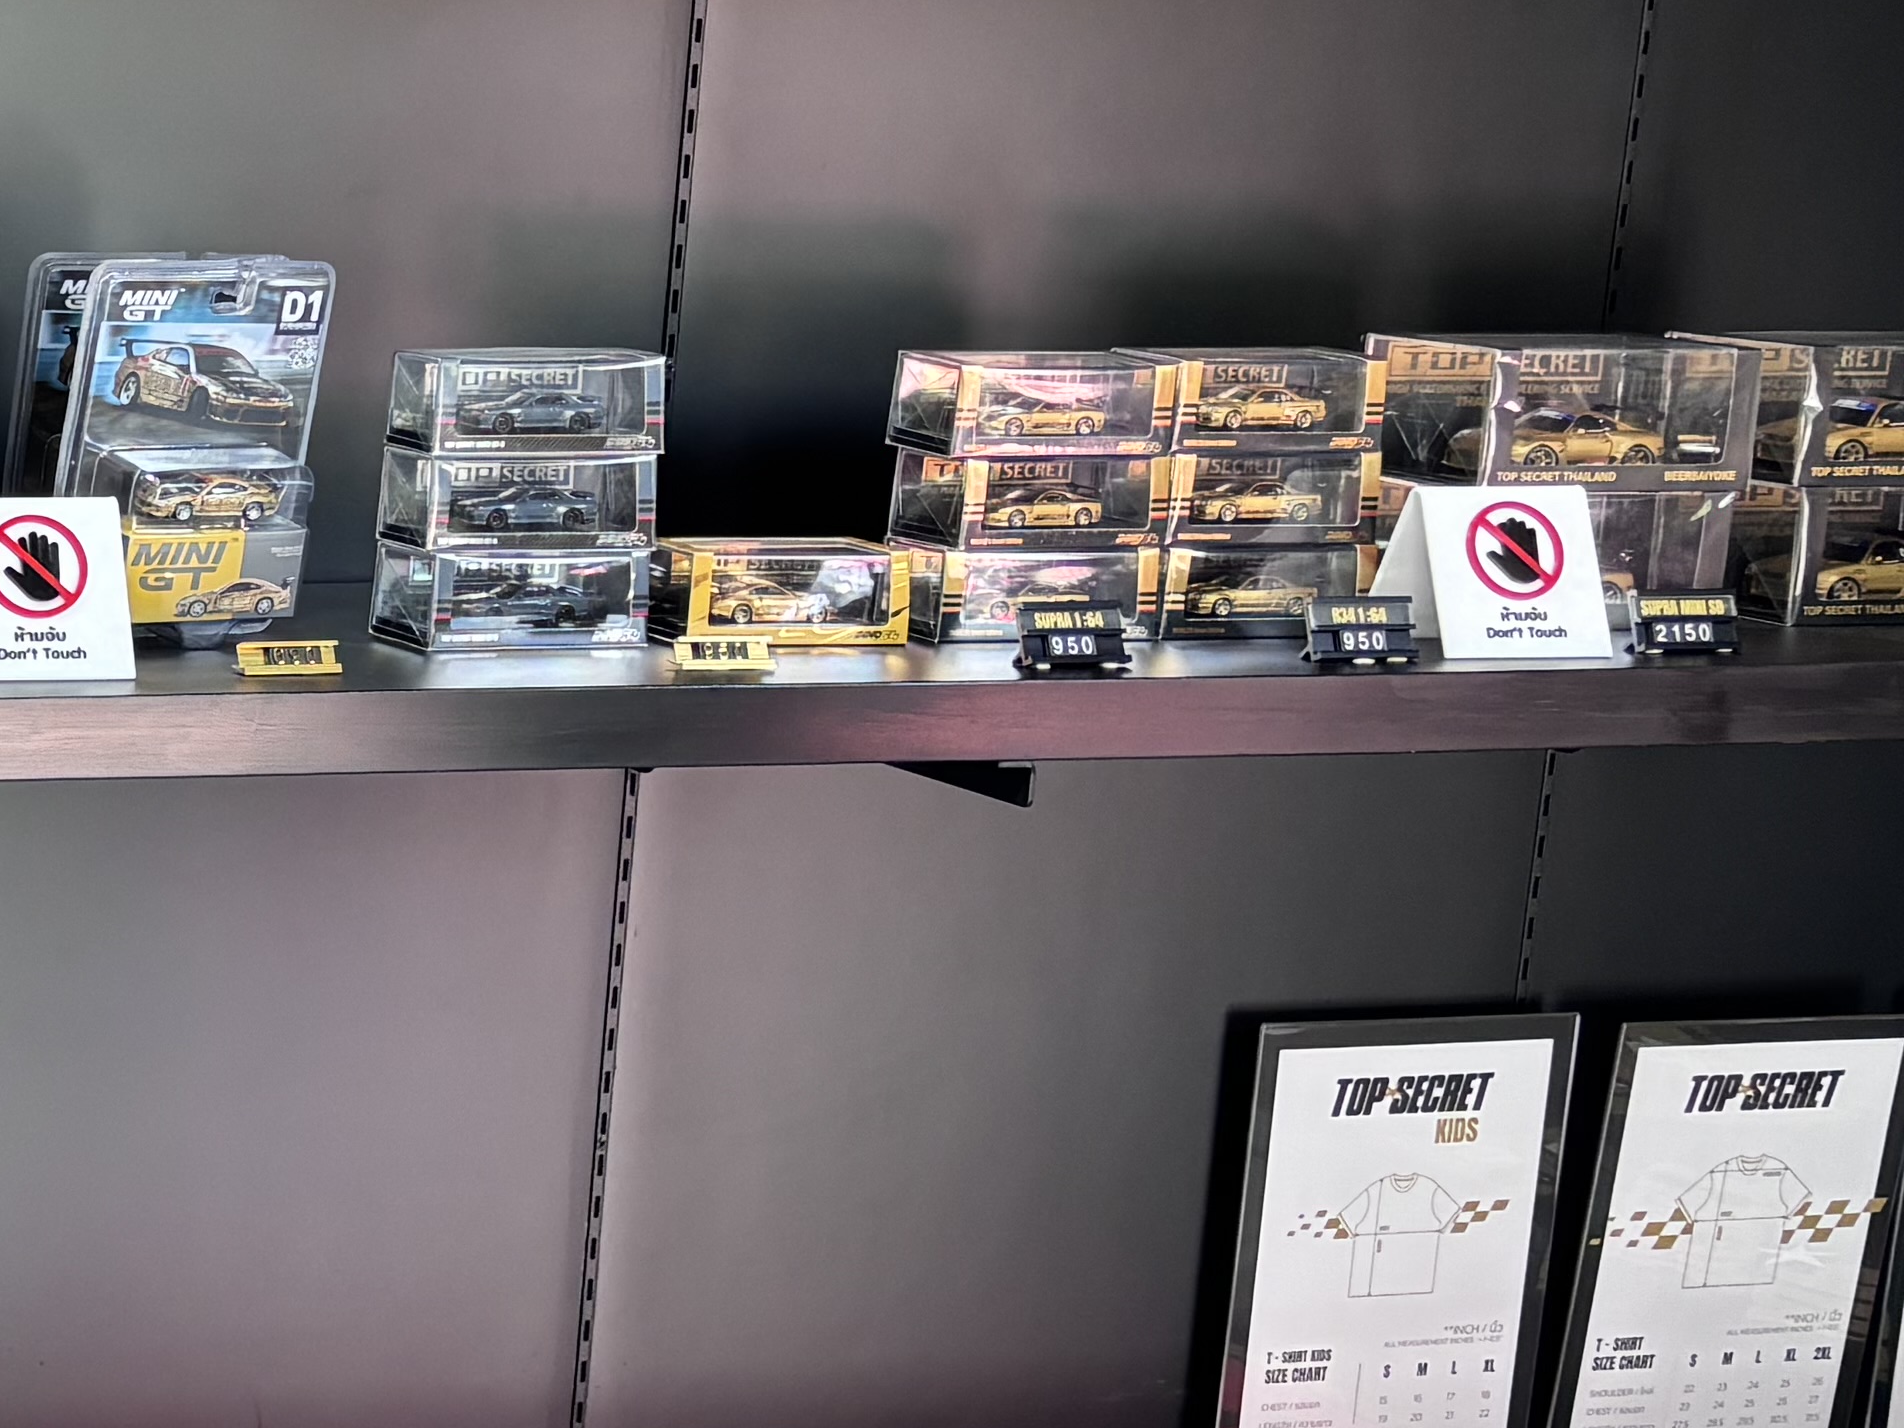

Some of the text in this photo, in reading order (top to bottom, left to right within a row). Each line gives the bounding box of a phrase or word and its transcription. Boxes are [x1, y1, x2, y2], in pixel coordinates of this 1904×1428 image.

[119, 289, 178, 308] MINI
[281, 289, 325, 324] D1
[122, 305, 172, 321] GT
[1403, 351, 1485, 372] TOP
[1213, 366, 1281, 384] SECRET
[1001, 463, 1067, 481] SECRET
[1497, 471, 1617, 482] TOP SECRET THAILAND
[131, 541, 229, 567] MINI
[139, 566, 219, 592] GT
[1033, 611, 1072, 629] SUPRA
[1500, 606, 1548, 622] ห้ามจับ
[14, 626, 67, 643] ห้ามจับ
[1342, 629, 1384, 651] 950
[1486, 626, 1568, 639] Don't Touch
[1654, 623, 1711, 642] 2150
[43, 647, 87, 660] Touch
[1050, 636, 1094, 655] 950
[1331, 1072, 1495, 1117] TOP SECRET
[1684, 1069, 1846, 1114] TOP SECRET
[1434, 1117, 1480, 1145] KIDS
[1383, 1360, 1458, 1379] S M L
[1592, 1354, 1656, 1372] SIZE CHART
